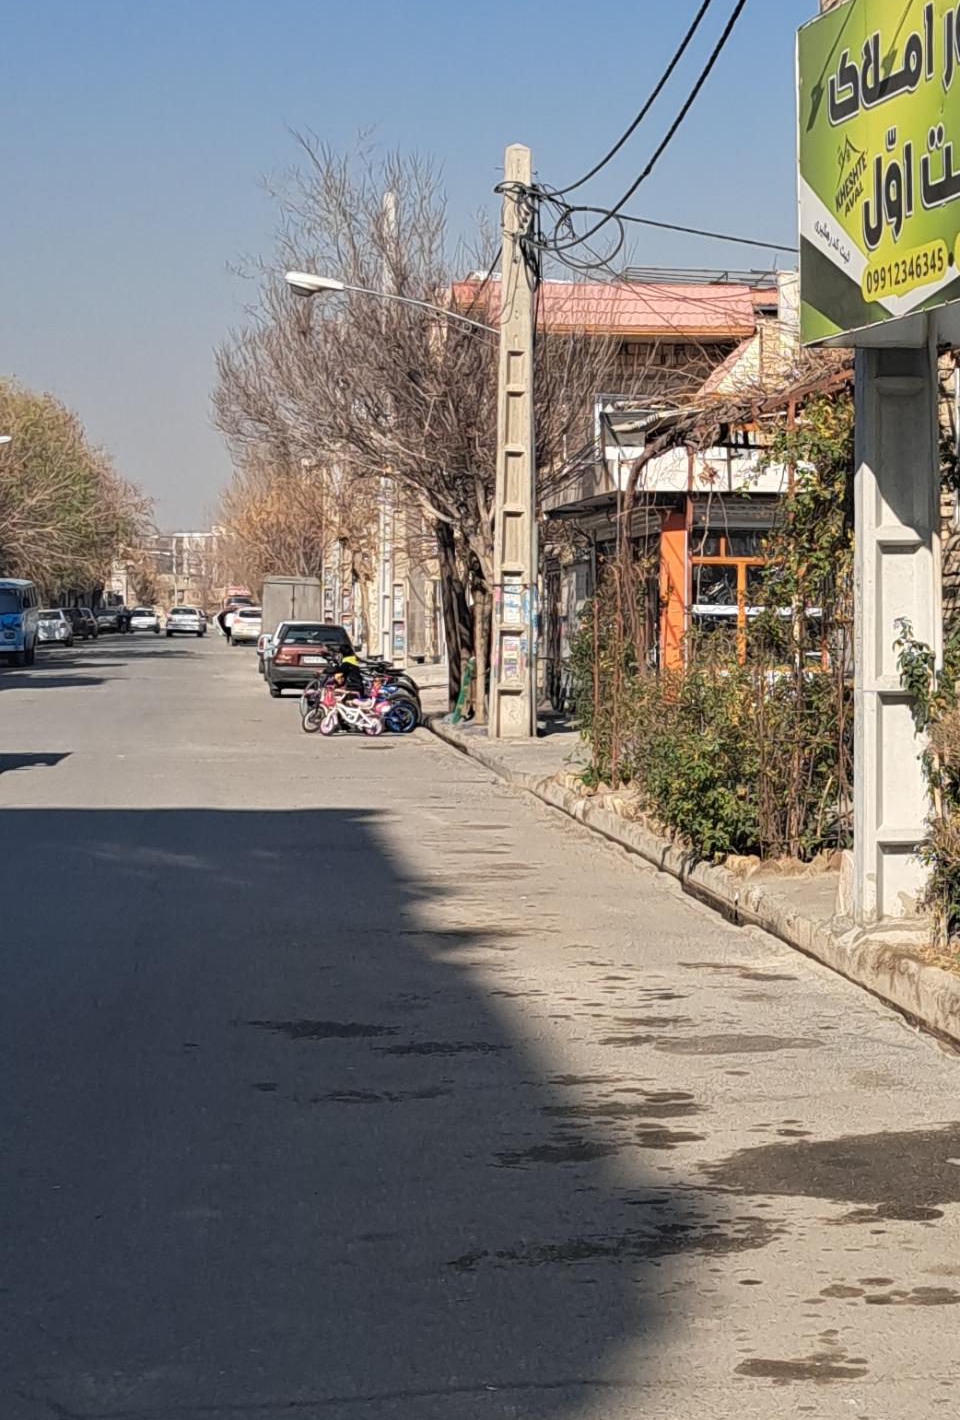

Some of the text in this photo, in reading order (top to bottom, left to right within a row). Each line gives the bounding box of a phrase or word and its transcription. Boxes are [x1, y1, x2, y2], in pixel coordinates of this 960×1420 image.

[828, 1, 934, 127] املاک
[845, 182, 863, 217] AVAL
[866, 246, 943, 294] 09912346345
